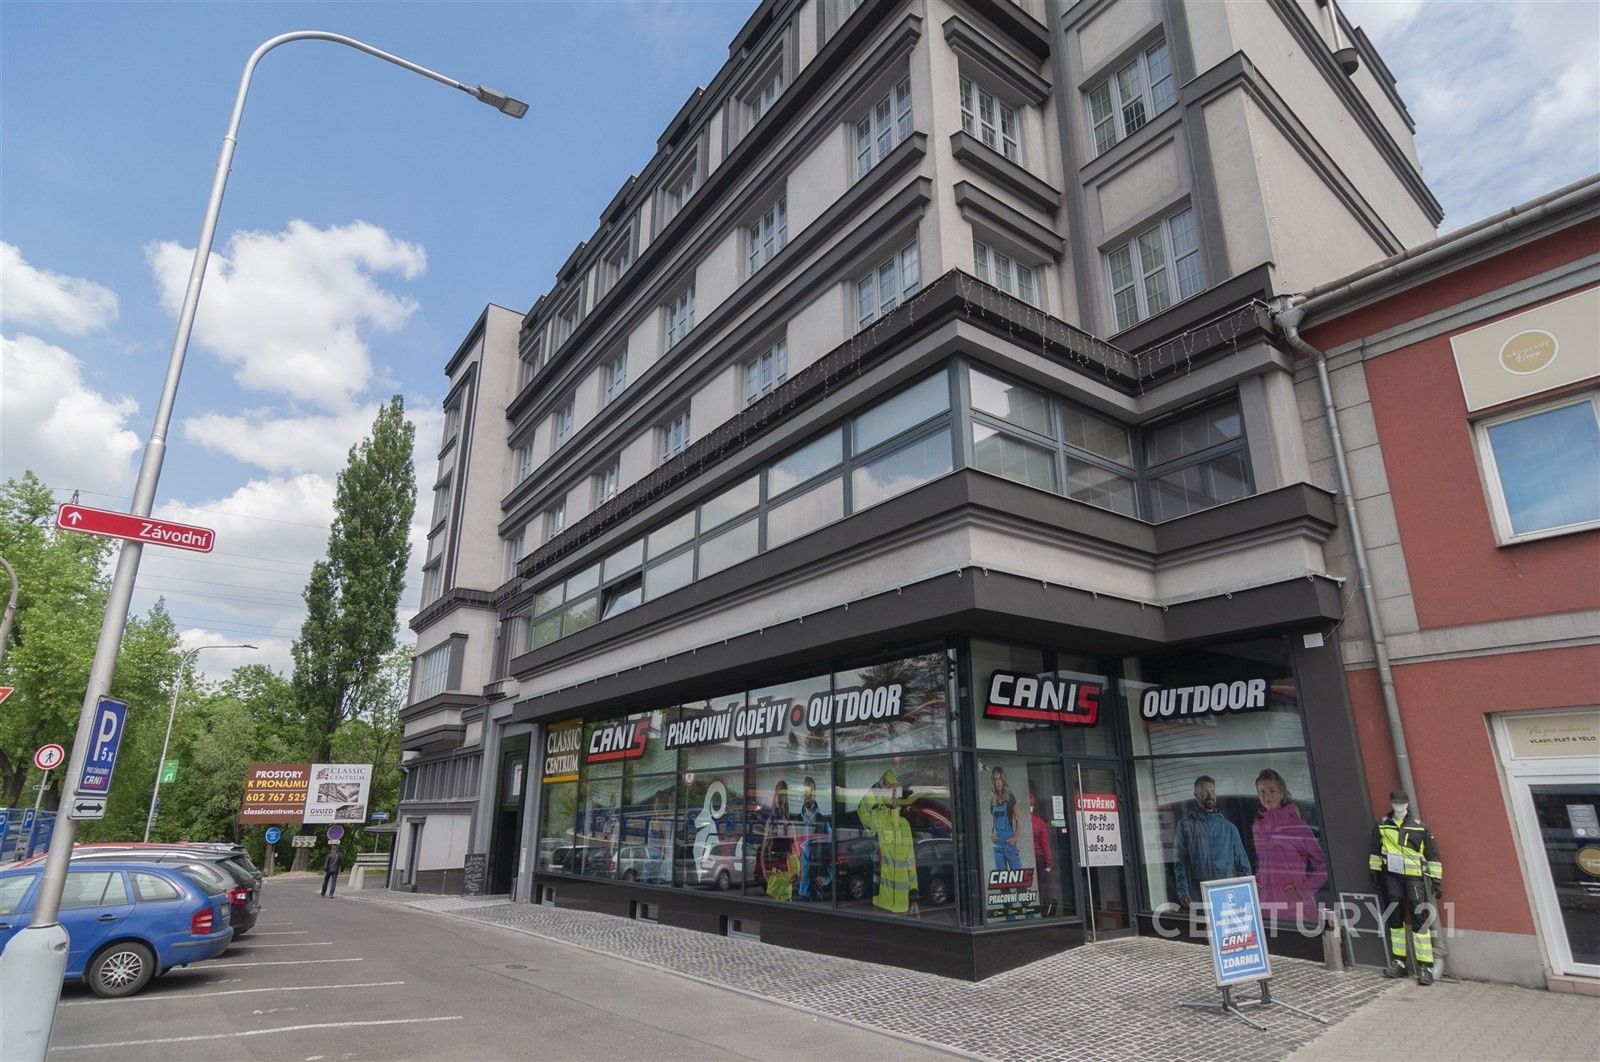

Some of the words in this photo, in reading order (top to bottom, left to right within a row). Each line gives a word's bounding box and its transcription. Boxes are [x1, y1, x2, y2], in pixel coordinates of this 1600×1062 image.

[140, 522, 207, 547] Závodní
[986, 674, 1100, 724] CANIS
[1143, 678, 1267, 718] OUTDOOR
[666, 706, 732, 747] PRACOVNÍ
[735, 702, 788, 736] ODĚVY
[808, 684, 903, 728] OUTDOOR
[547, 727, 581, 754] CLASSIC
[587, 720, 650, 762] CANIS
[545, 753, 578, 774] CENTRUM
[256, 770, 304, 779] PROSTORY
[256, 779, 308, 788] PRONÁJMU
[246, 793, 265, 801] 602
[268, 793, 285, 801] 767
[288, 793, 306, 801] 525
[1084, 823, 1115, 831] :00-17:00
[1087, 844, 1118, 852] :00-12:00
[988, 868, 1034, 889] CANIS
[1223, 953, 1260, 969] ZDARMA
